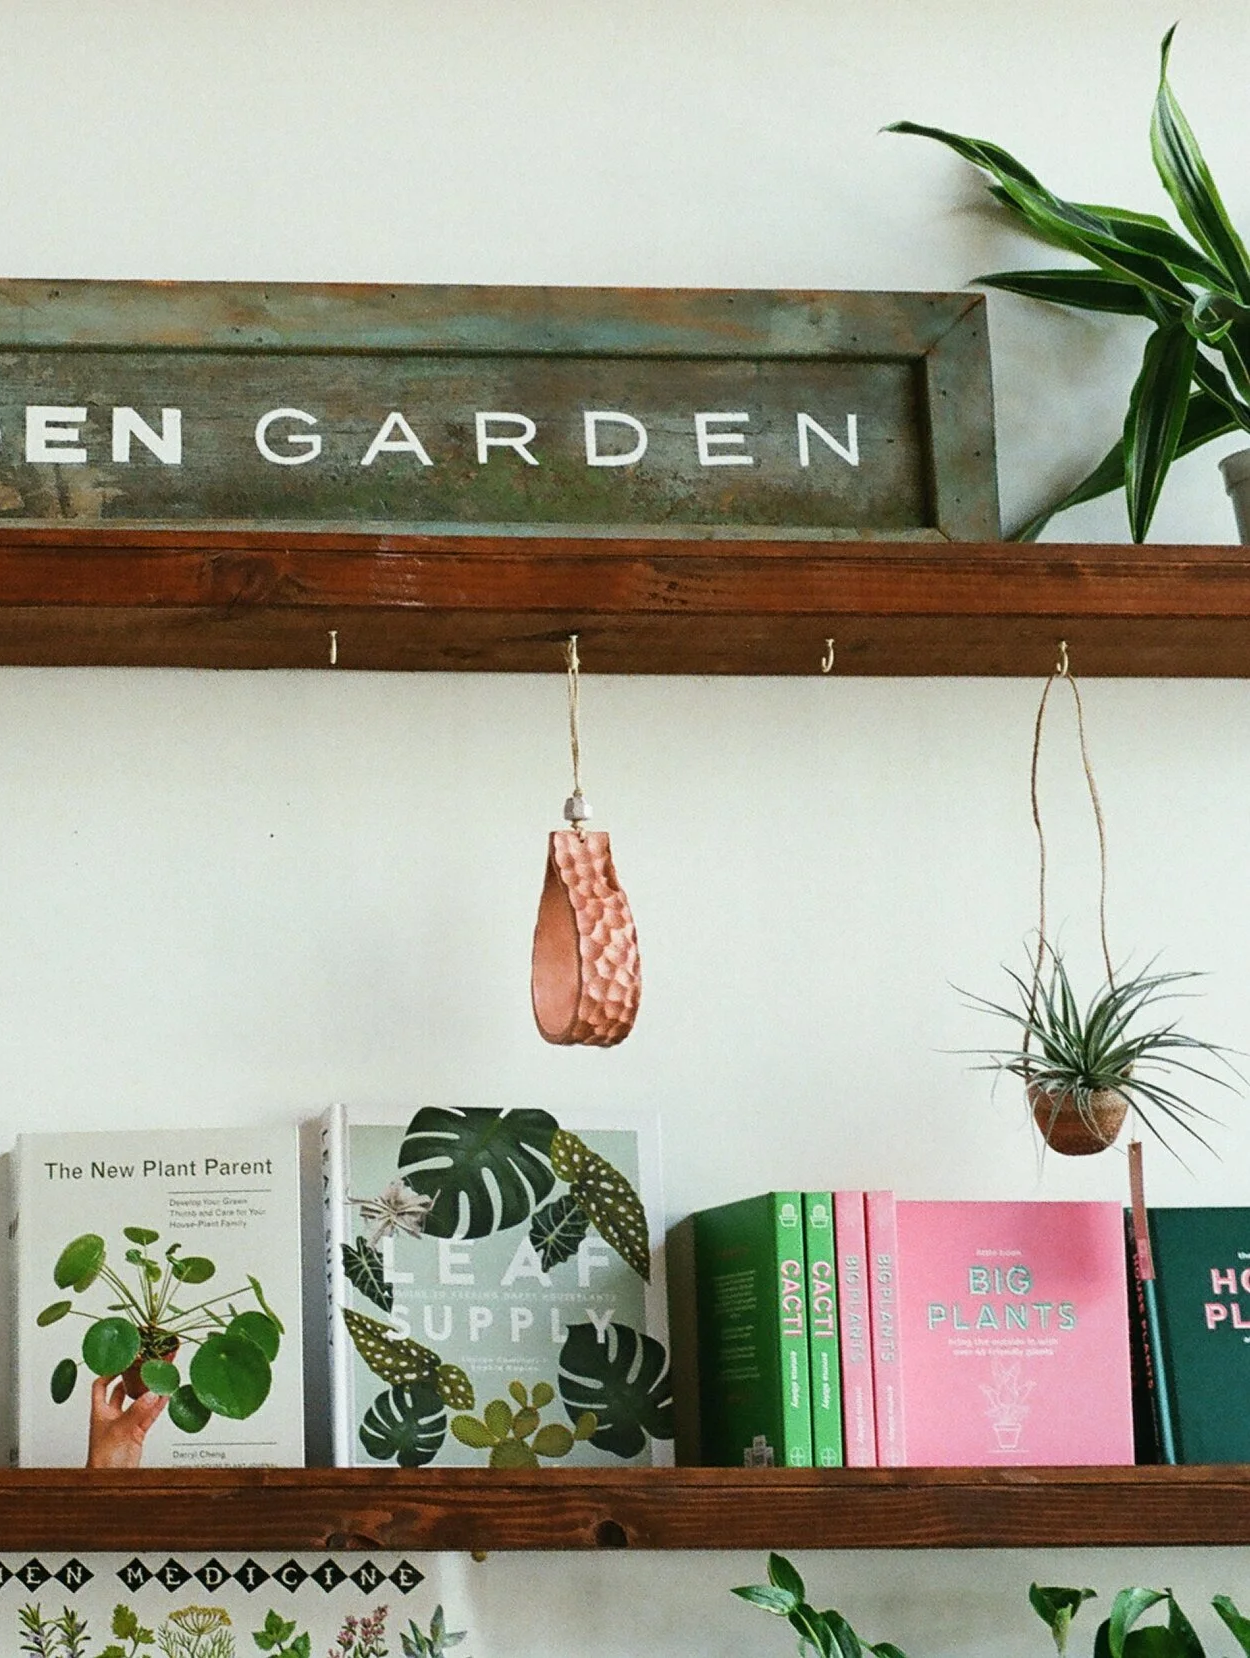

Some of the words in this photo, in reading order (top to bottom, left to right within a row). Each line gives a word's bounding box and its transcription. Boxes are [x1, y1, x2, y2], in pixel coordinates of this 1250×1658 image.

[254, 407, 860, 467] GARDEN
[44, 1162, 83, 1180] The
[91, 1160, 135, 1179] New
[143, 1159, 197, 1178] Plant
[205, 1157, 273, 1176] Parent
[382, 1235, 612, 1289] LEAF
[844, 1254, 861, 1286] BIG
[877, 1254, 893, 1285] BIG
[969, 1264, 1033, 1296] BIG
[780, 1259, 803, 1338] CACTI
[811, 1260, 835, 1339] CACTI
[927, 1301, 1078, 1331] PLANTS
[381, 1303, 617, 1345] SUPPLY
[848, 1287, 866, 1365] PLANTS
[878, 1287, 896, 1364] PLANTS
[125, 1566, 415, 1587] MEDICINE
